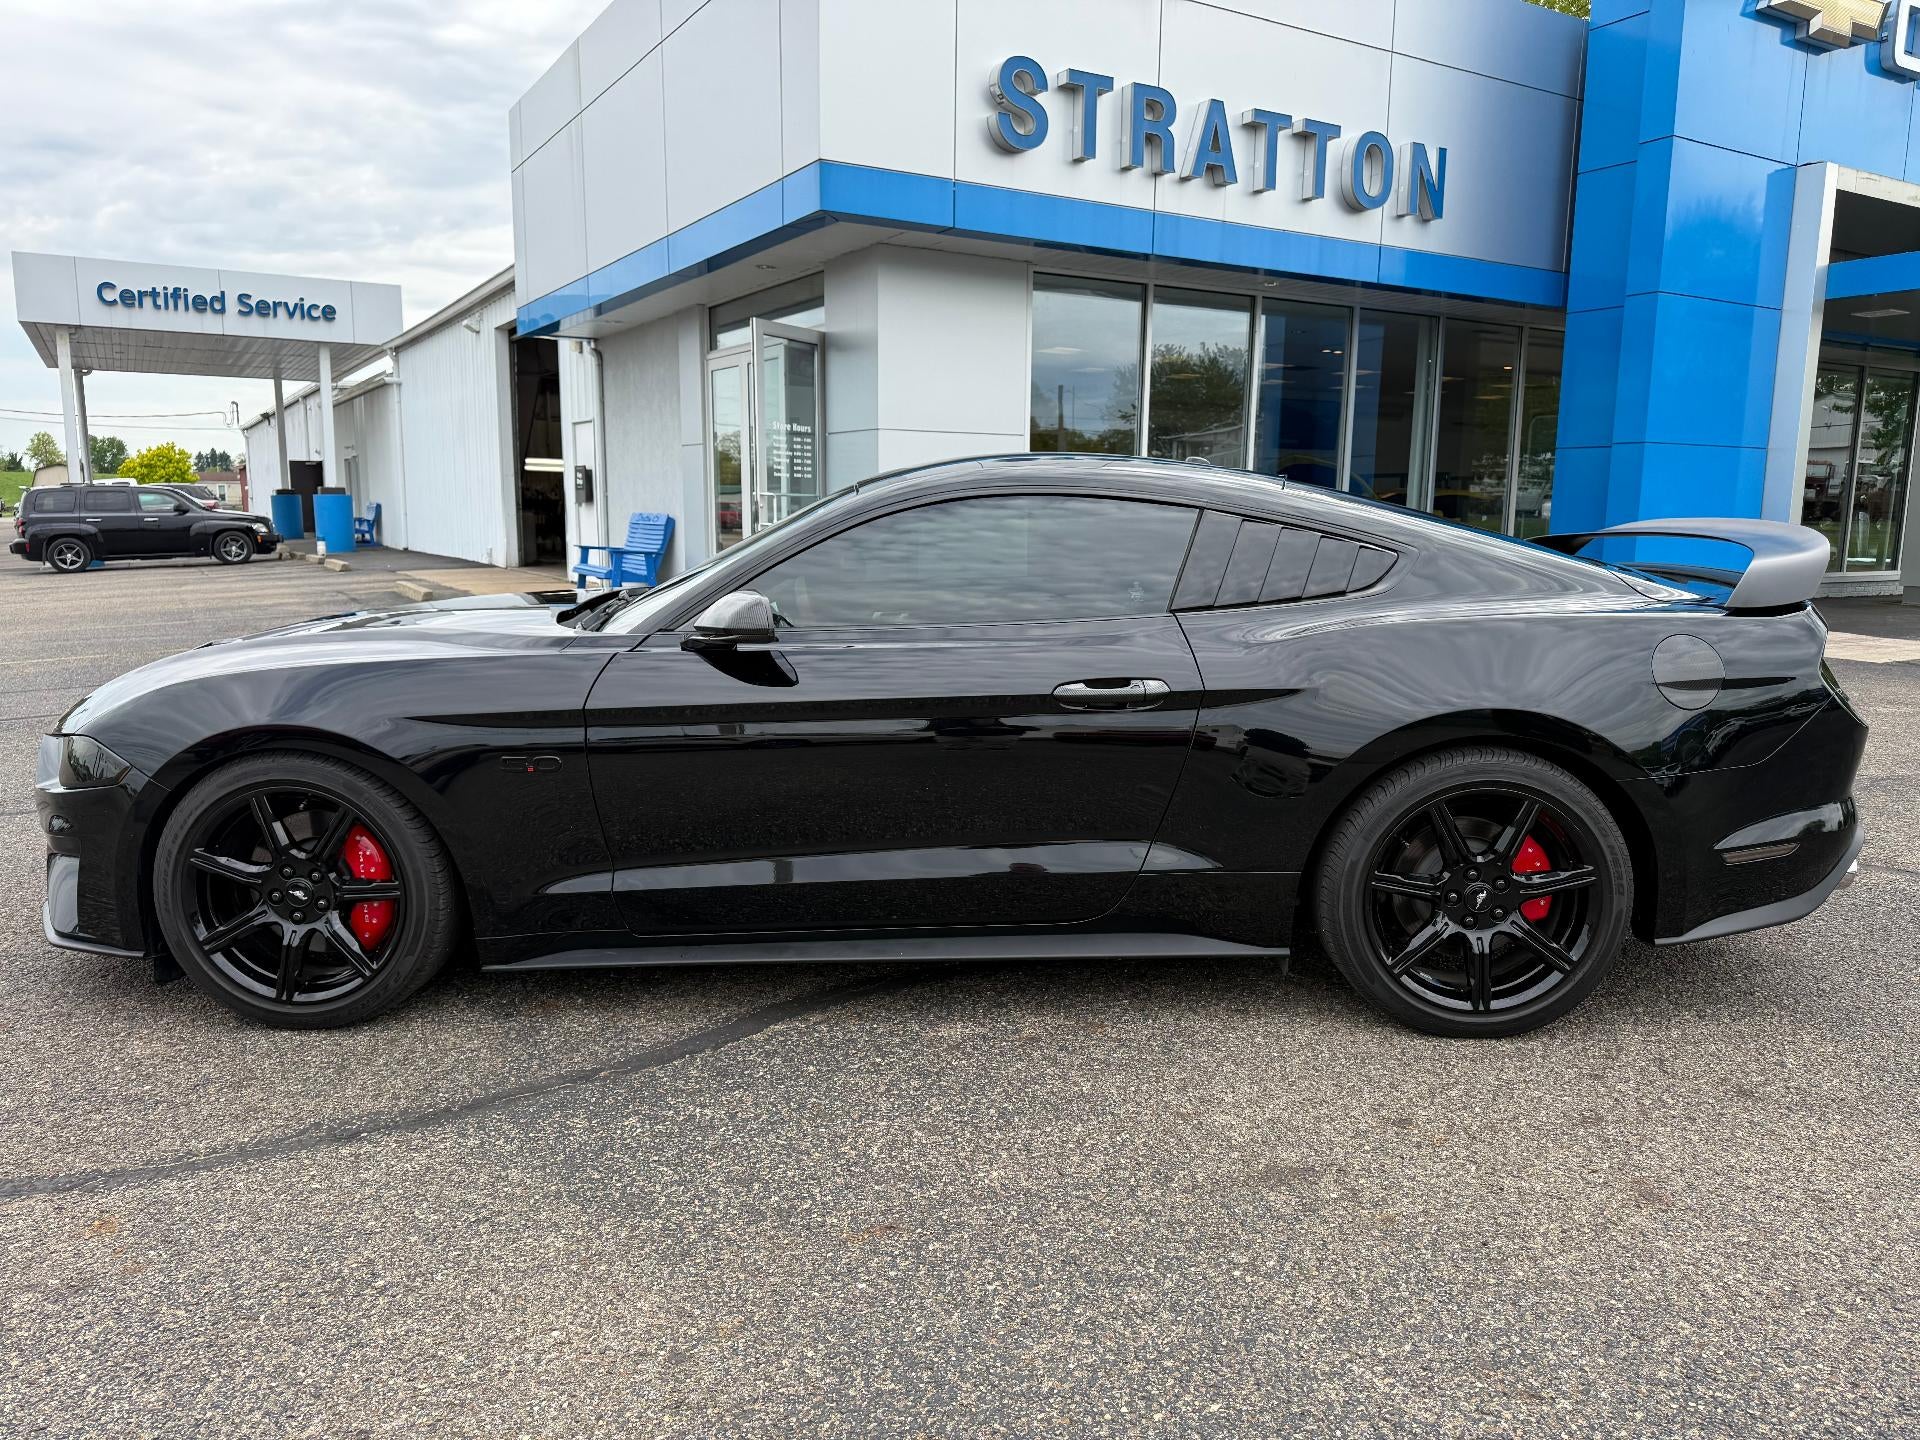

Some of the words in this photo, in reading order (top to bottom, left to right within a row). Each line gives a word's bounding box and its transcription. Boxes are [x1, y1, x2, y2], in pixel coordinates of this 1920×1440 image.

[988, 55, 1447, 222] STRATTON
[96, 281, 226, 315] Certified
[236, 292, 337, 322] Service
[772, 421, 791, 431] Store
[792, 423, 812, 433] Hours
